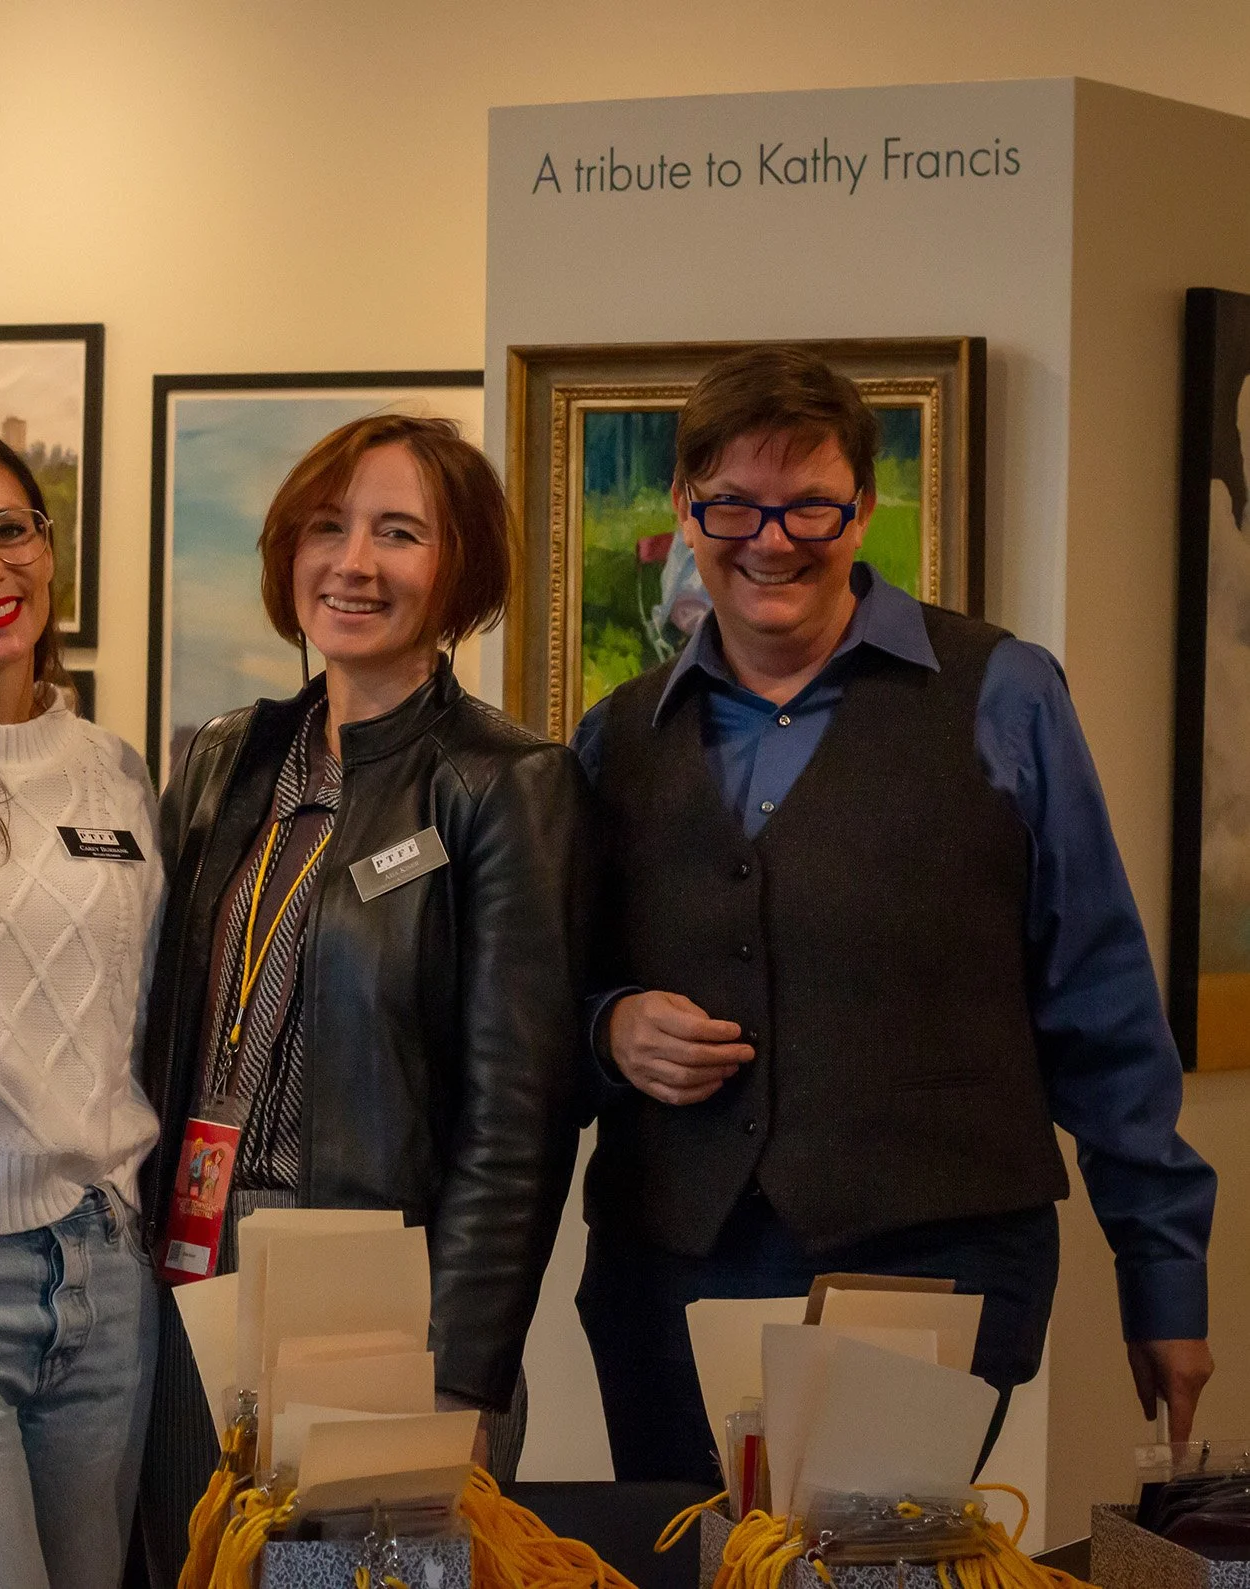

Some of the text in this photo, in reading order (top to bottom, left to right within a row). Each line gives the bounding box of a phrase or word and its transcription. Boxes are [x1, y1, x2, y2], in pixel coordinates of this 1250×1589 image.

[533, 138, 1020, 195] A tribute to Kathy Francis
